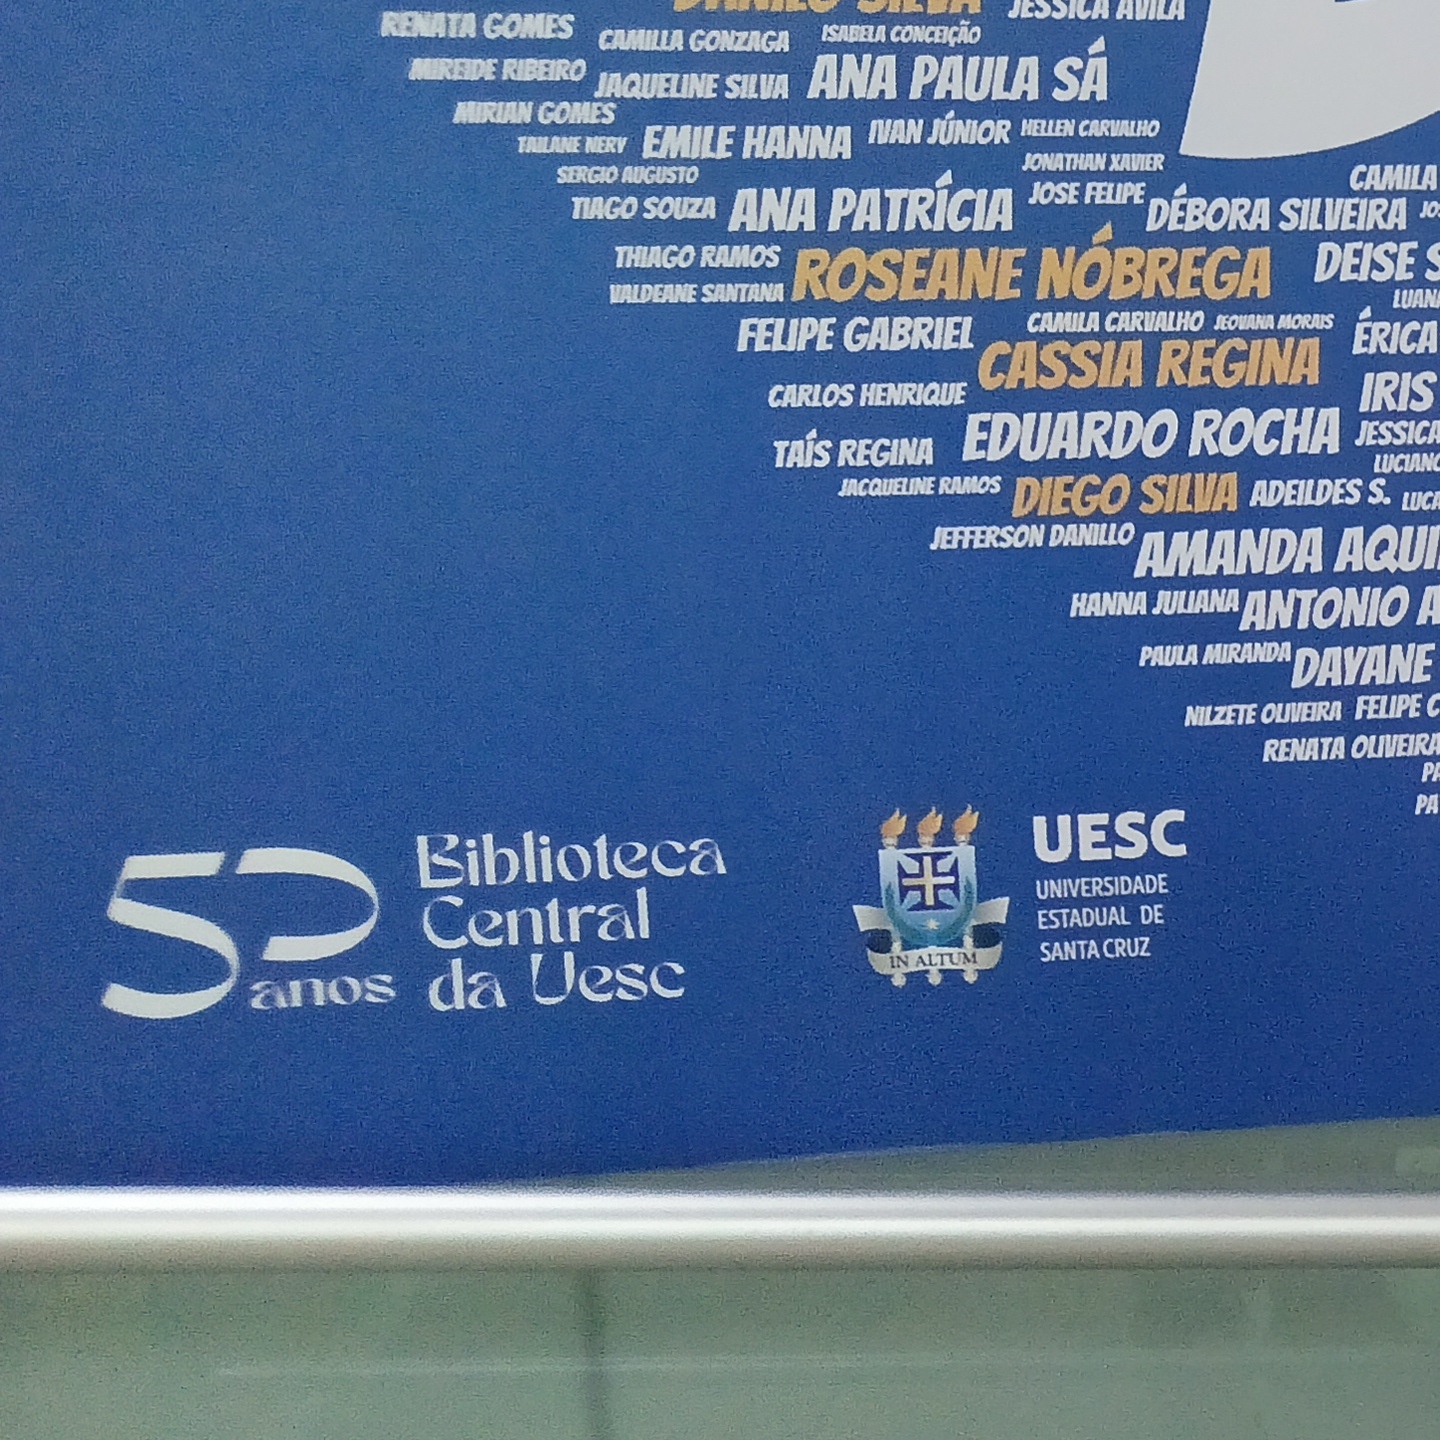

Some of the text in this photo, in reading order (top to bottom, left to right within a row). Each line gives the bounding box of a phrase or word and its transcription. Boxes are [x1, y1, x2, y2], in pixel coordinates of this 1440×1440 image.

[792, 221, 1271, 302] ROSEANE NÓBREGA
[978, 337, 1319, 390] CASSIA REGINA
[963, 407, 1339, 461] EDUARDO ROCHA
[417, 831, 726, 888] Biblioteca
[1033, 809, 1187, 862] UESC
[1036, 874, 1168, 899] UNIVERSIDADE
[423, 887, 649, 949] Central
[1038, 904, 1164, 929] ESTADUAL DE
[889, 951, 978, 969] IN ALTUM
[1040, 937, 1151, 962] SANTA CRUZ
[250, 975, 396, 1009] anos
[429, 951, 684, 1011] da Uesc
